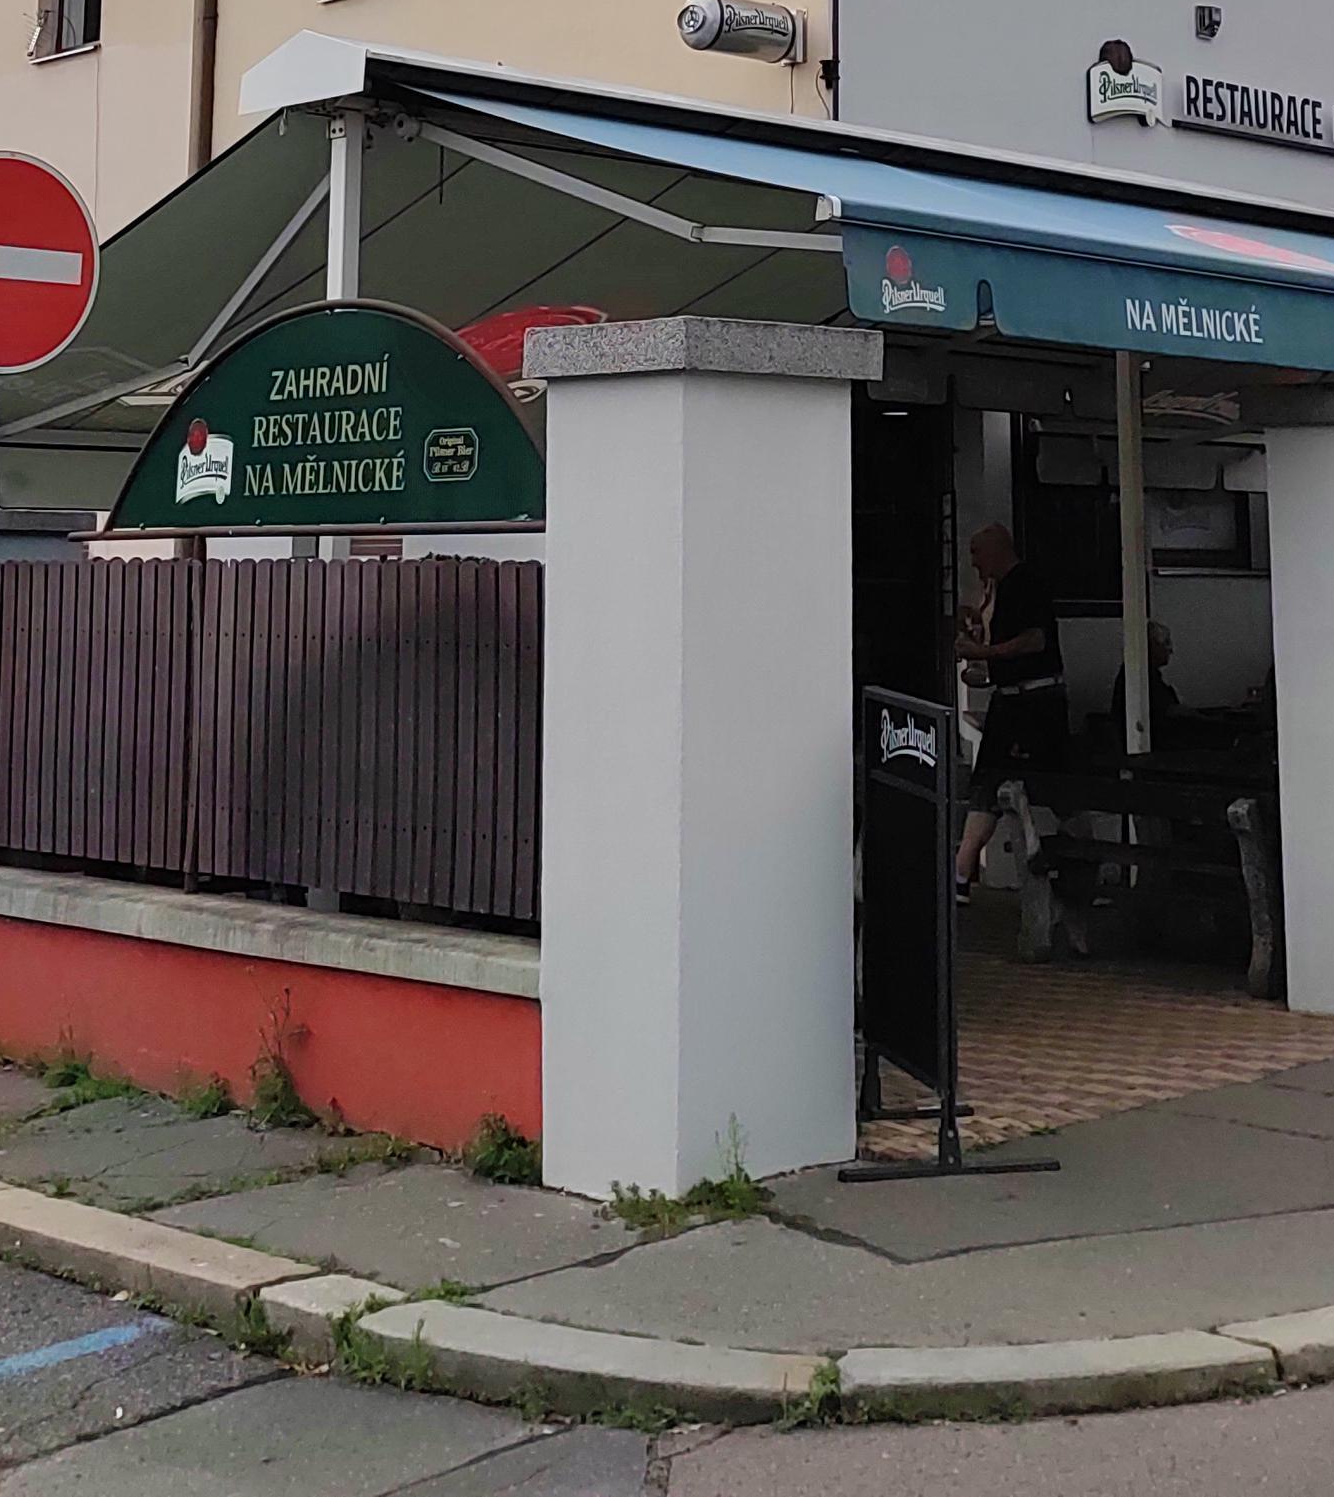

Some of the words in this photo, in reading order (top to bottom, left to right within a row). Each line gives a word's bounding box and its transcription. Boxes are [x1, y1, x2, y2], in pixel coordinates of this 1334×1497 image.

[725, 5, 758, 33] Pilsner
[1099, 71, 1133, 103] Pilsner
[1185, 75, 1323, 140] RESTAURACE
[882, 278, 912, 314] Pilsner
[911, 280, 946, 311] Urquell
[1125, 298, 1157, 332] NA
[1161, 297, 1264, 344] MĚLNICKÉ
[269, 353, 389, 401] ZAHRADNÍ
[252, 407, 402, 448] RESTAURACE
[180, 455, 206, 489] Pilsner
[243, 463, 275, 496] NA
[281, 450, 405, 496] MĚLNICKÉ
